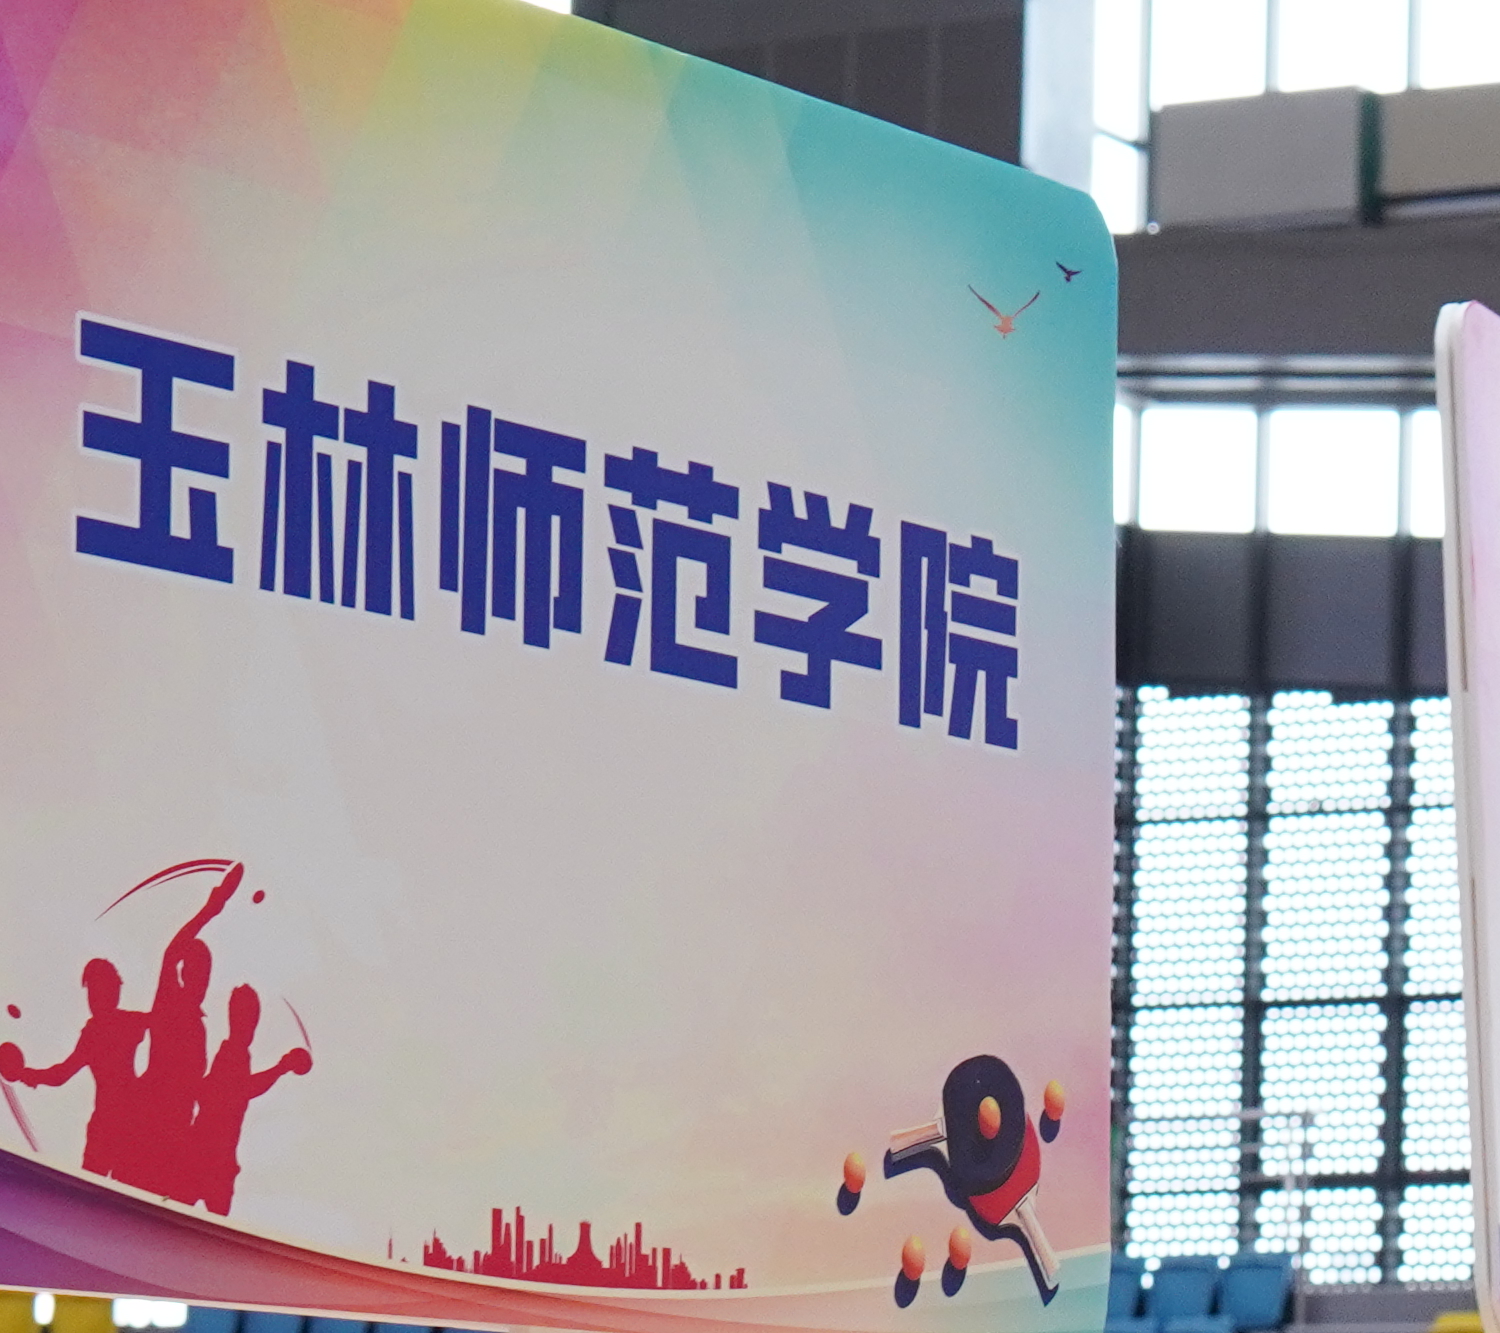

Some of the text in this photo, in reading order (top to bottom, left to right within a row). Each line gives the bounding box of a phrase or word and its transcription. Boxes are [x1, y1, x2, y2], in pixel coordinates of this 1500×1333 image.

[75, 312, 1021, 751] 玉林师范学院
